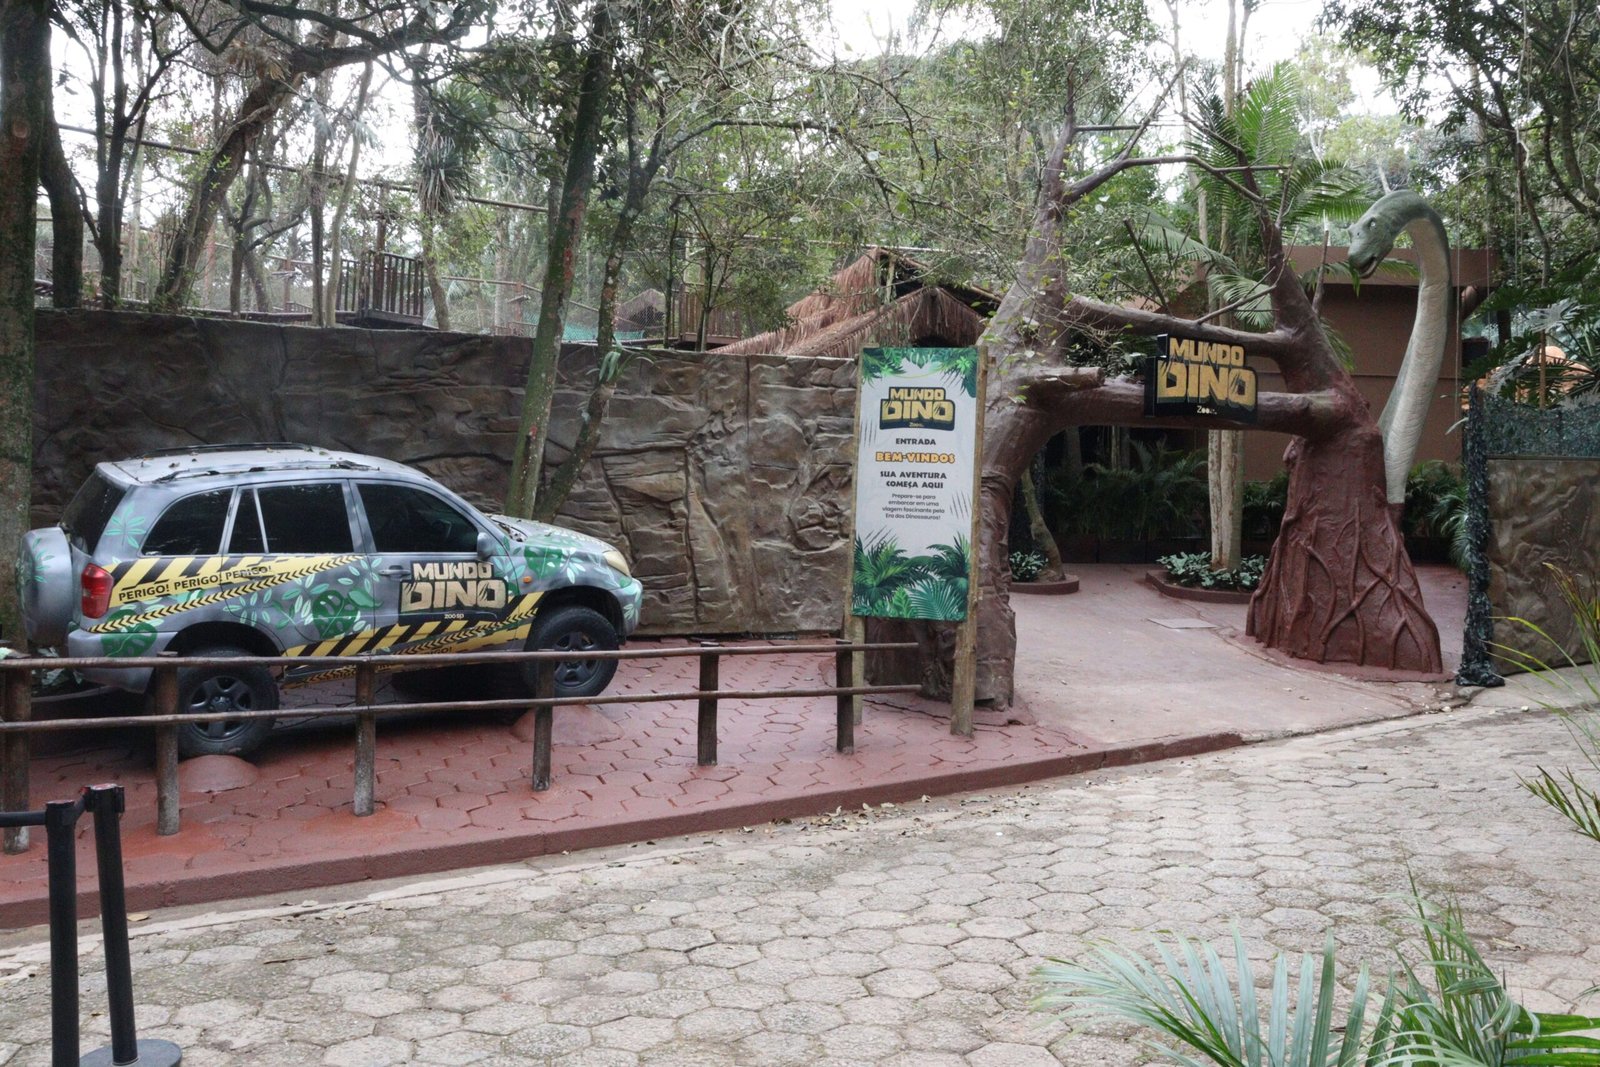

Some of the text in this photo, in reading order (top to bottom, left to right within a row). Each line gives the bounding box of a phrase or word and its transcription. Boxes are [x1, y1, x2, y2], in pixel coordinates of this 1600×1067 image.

[1169, 338, 1244, 367] MUNDO
[1157, 360, 1256, 406] DINO
[890, 388, 944, 400] MUNDO
[882, 401, 953, 421] DINO
[875, 451, 955, 464] BEM-VINDOS
[899, 471, 947, 479] AVENTURA
[886, 481, 918, 489] COMEÇA
[413, 562, 493, 580] MUNDO
[119, 565, 272, 601] PERIGO! PERIGO! PERIGO!
[401, 580, 506, 612] DINO
